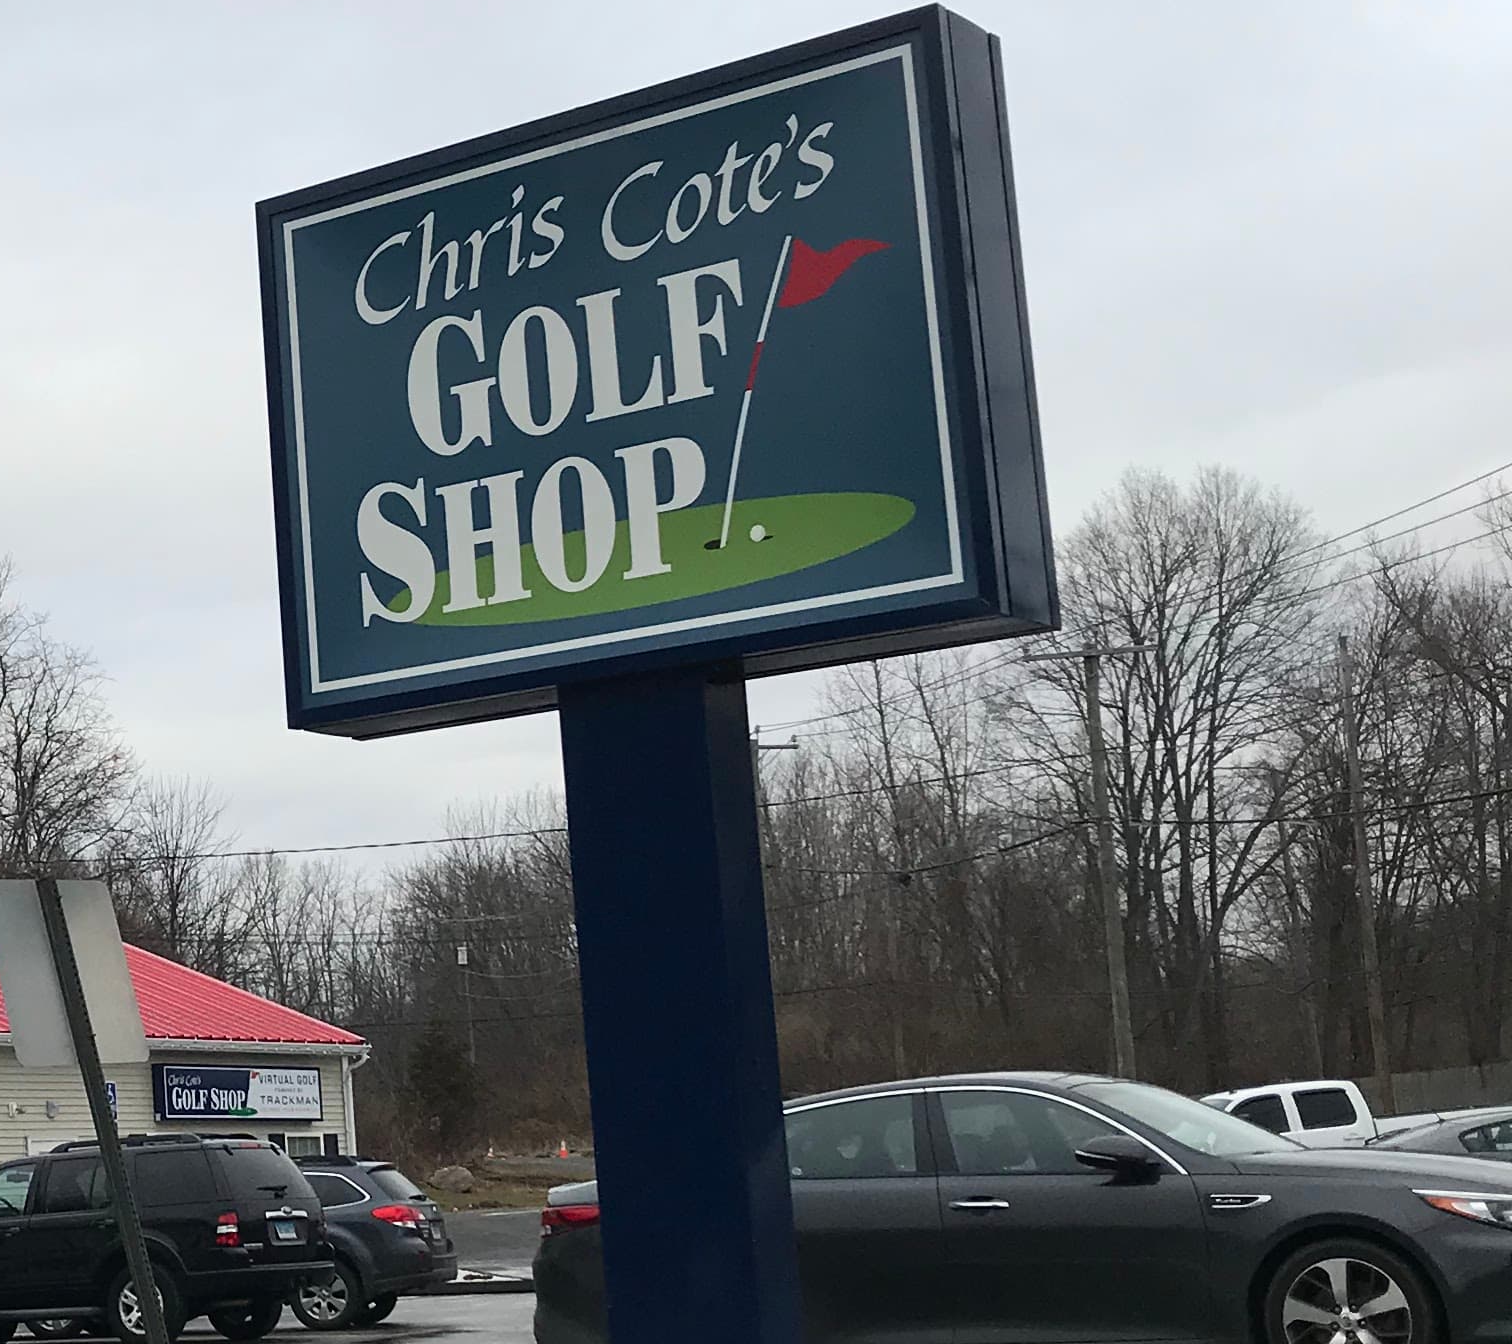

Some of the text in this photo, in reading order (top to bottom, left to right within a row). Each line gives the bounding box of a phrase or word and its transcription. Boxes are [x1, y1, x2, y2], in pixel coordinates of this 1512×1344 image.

[355, 112, 836, 326] Chris Cote's
[407, 258, 745, 457] GOLF
[355, 436, 707, 629] SHOP
[171, 1086, 247, 1111] GOLF SHOP
[259, 1074, 316, 1085] VIRTUAL GOLF
[259, 1095, 319, 1105] TRACKMAN
